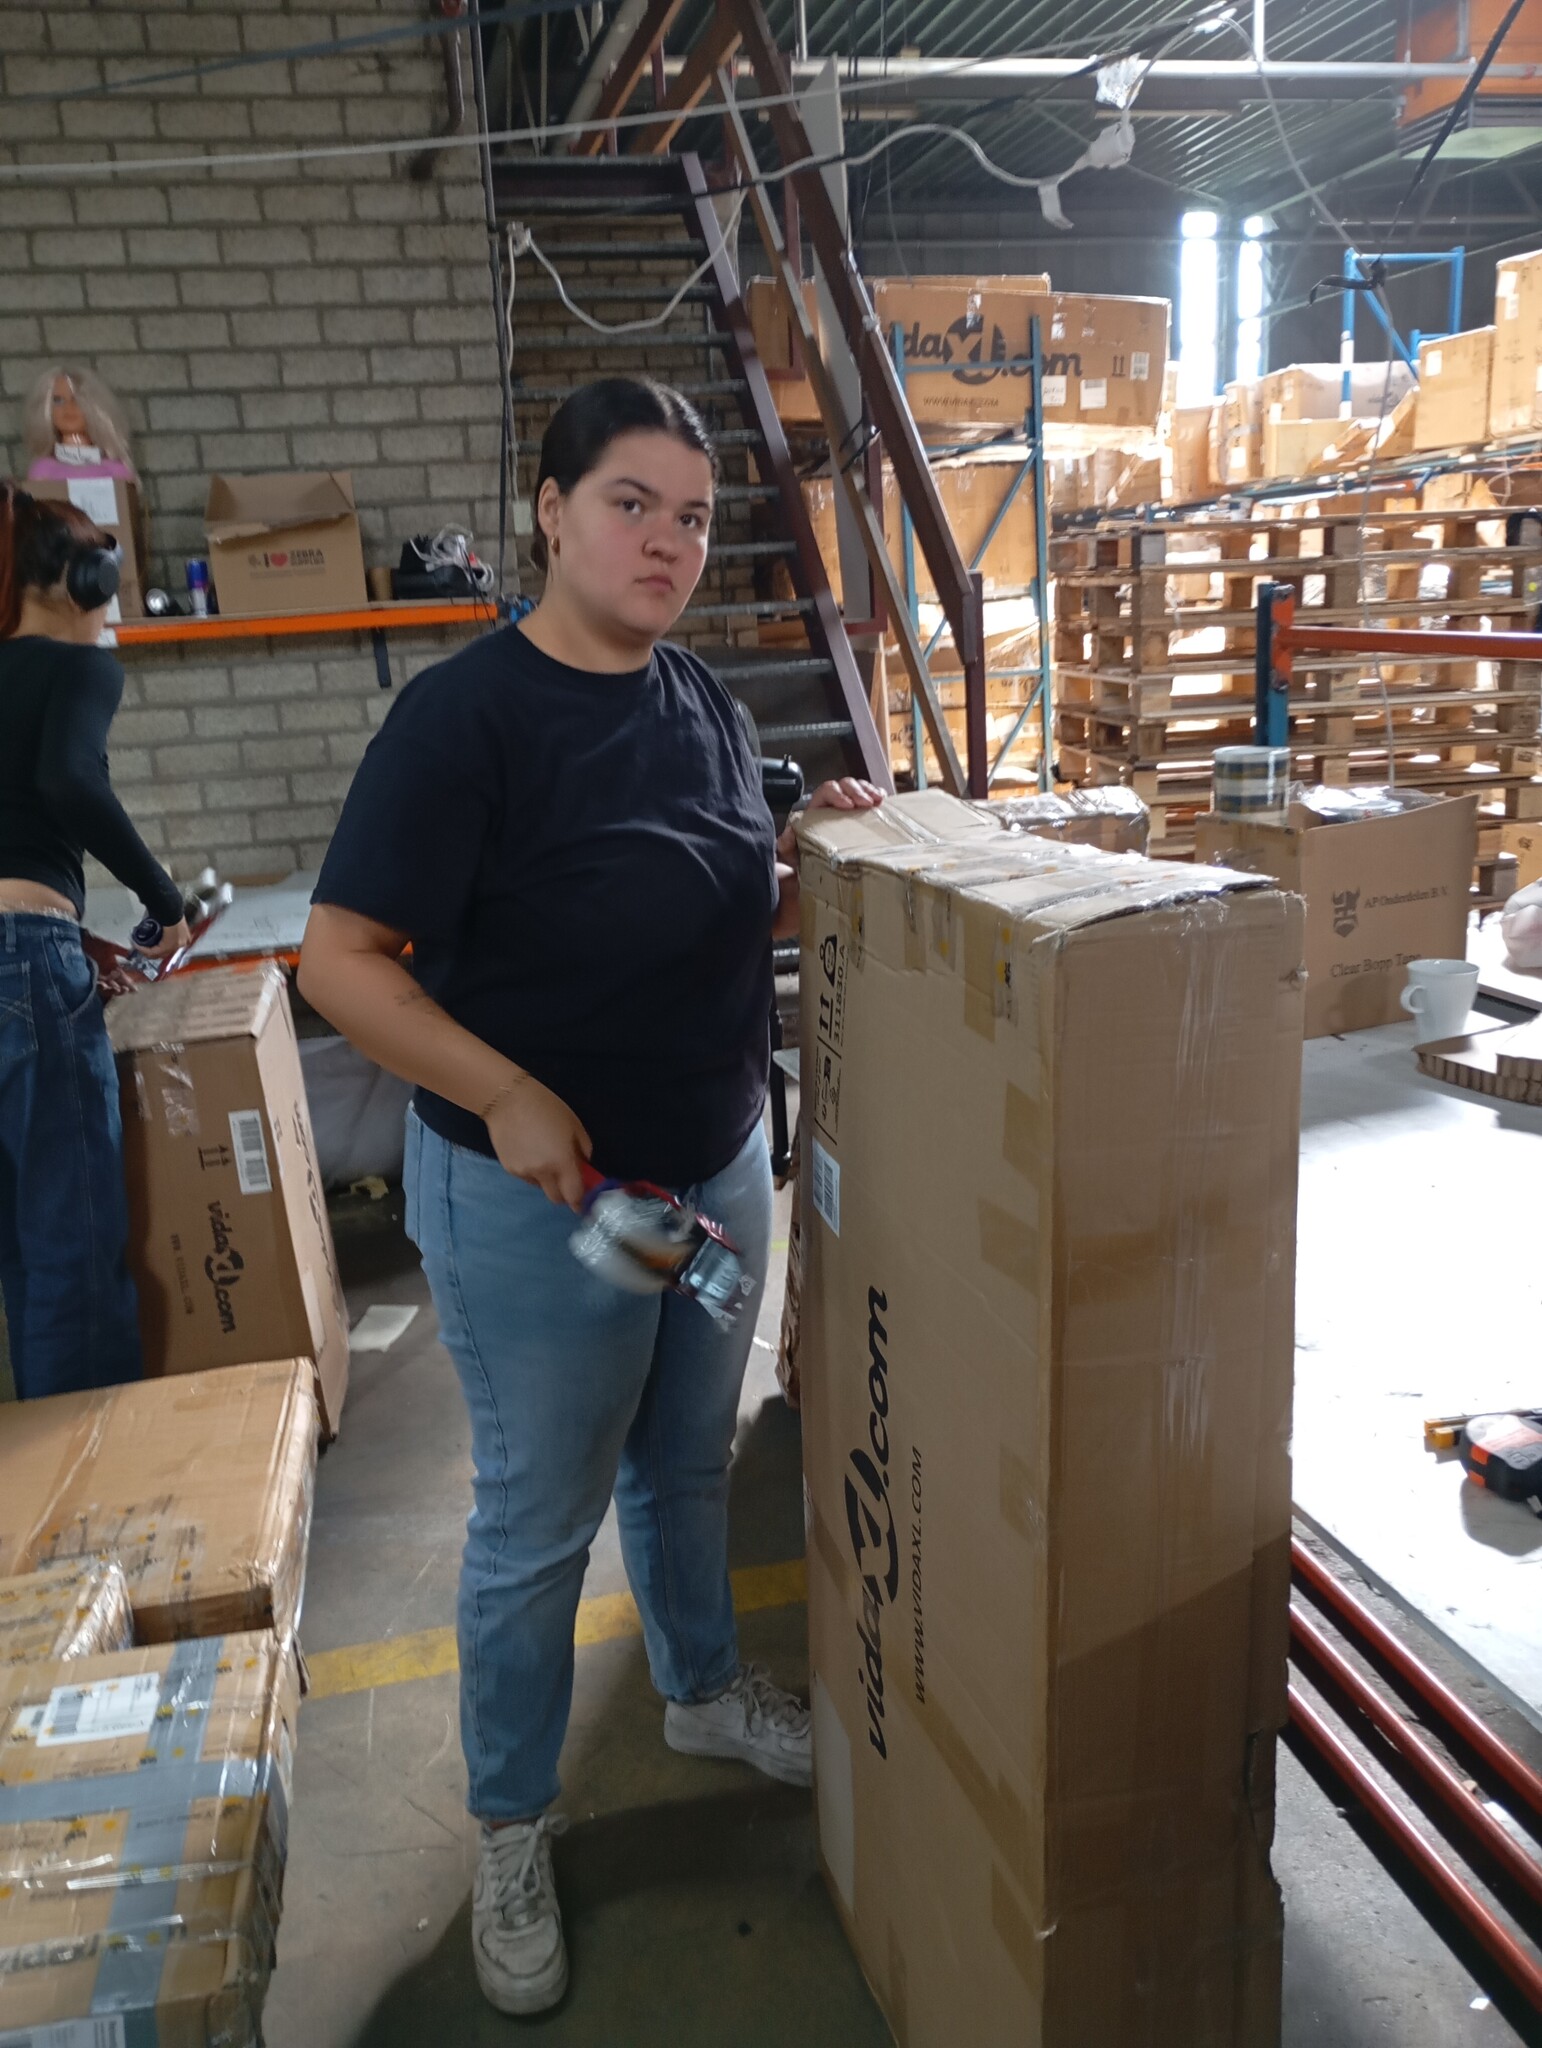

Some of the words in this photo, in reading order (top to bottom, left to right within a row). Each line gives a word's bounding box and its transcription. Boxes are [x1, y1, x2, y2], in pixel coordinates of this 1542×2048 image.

[886, 314, 1082, 385] daXL.cm
[1330, 963, 1361, 977] Clear
[1363, 958, 1393, 972] Bopp
[912, 1446, 926, 1704] WWW.VIDAXL.COM
